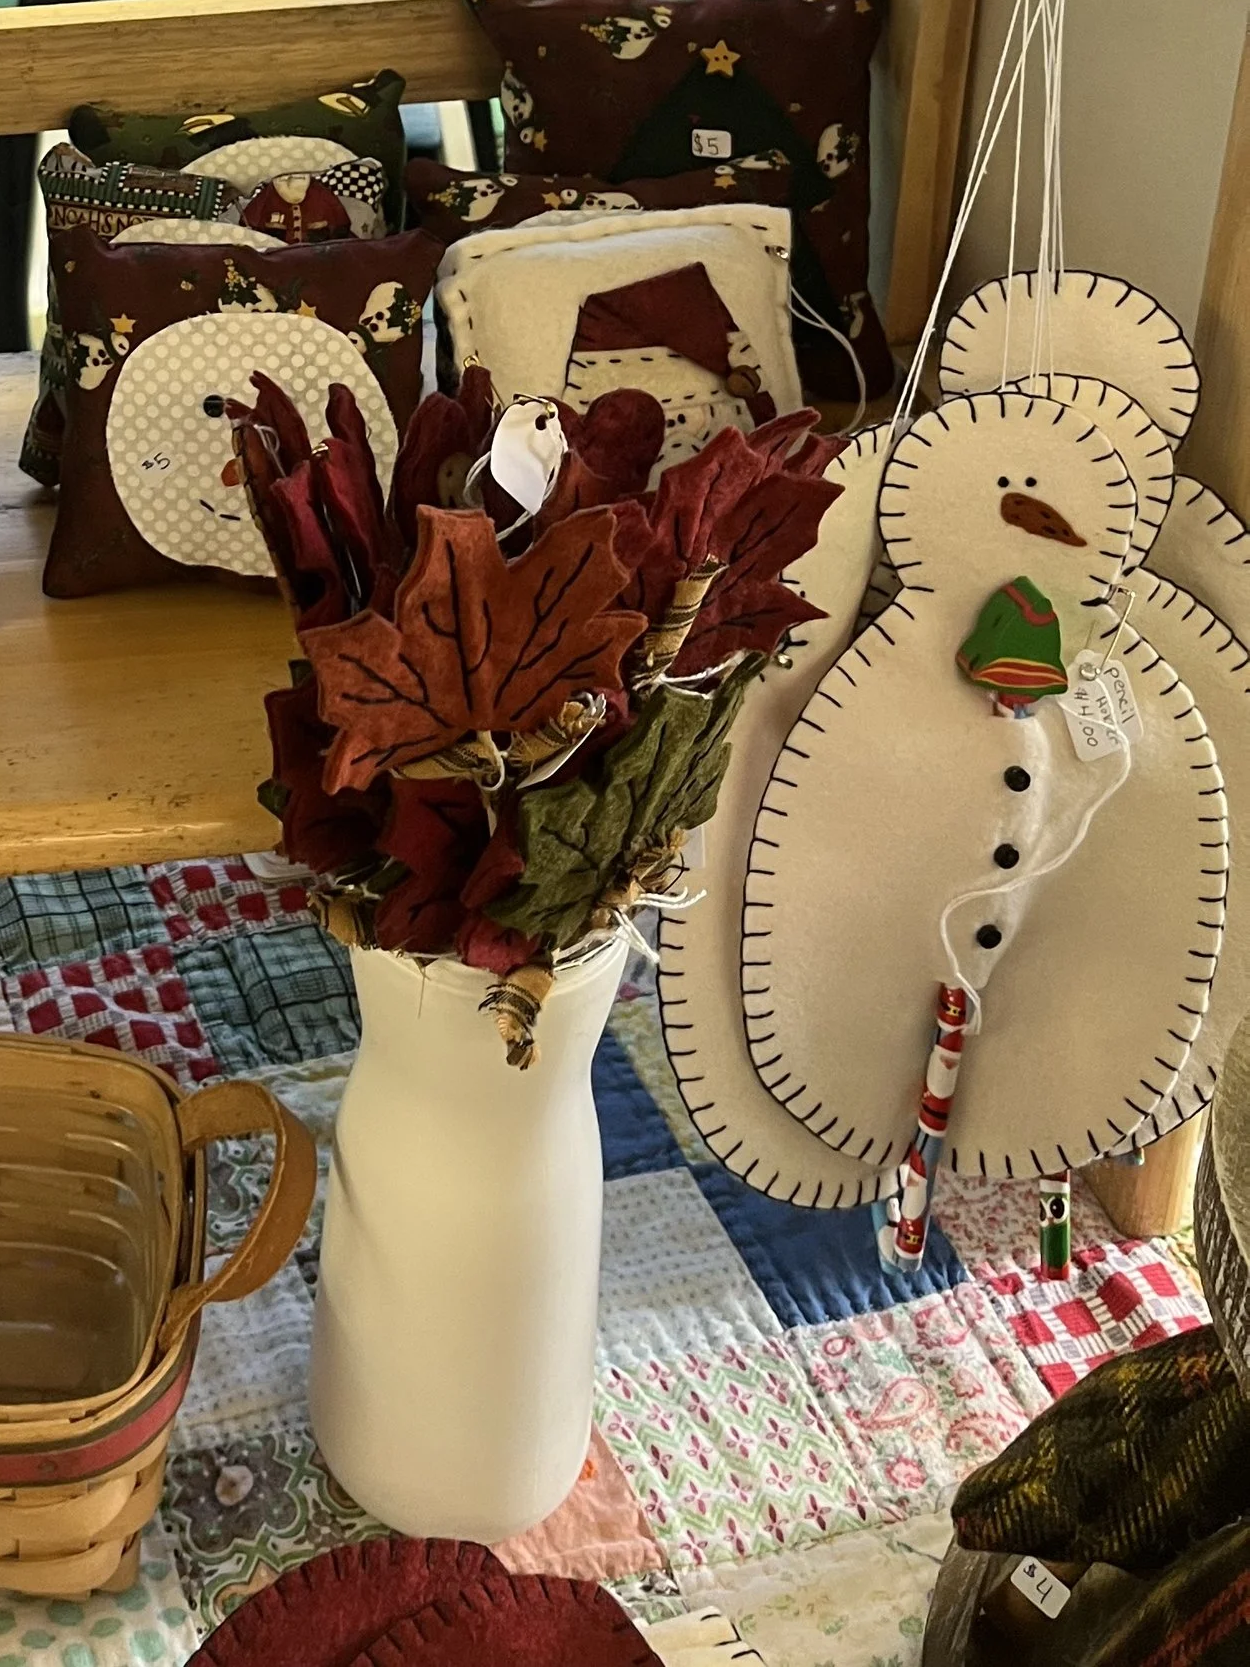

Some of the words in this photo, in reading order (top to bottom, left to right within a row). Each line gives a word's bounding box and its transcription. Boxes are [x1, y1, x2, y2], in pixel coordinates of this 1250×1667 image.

[693, 133, 720, 156] $5
[141, 452, 171, 470] $5
[1023, 1562, 1054, 1605] $4
